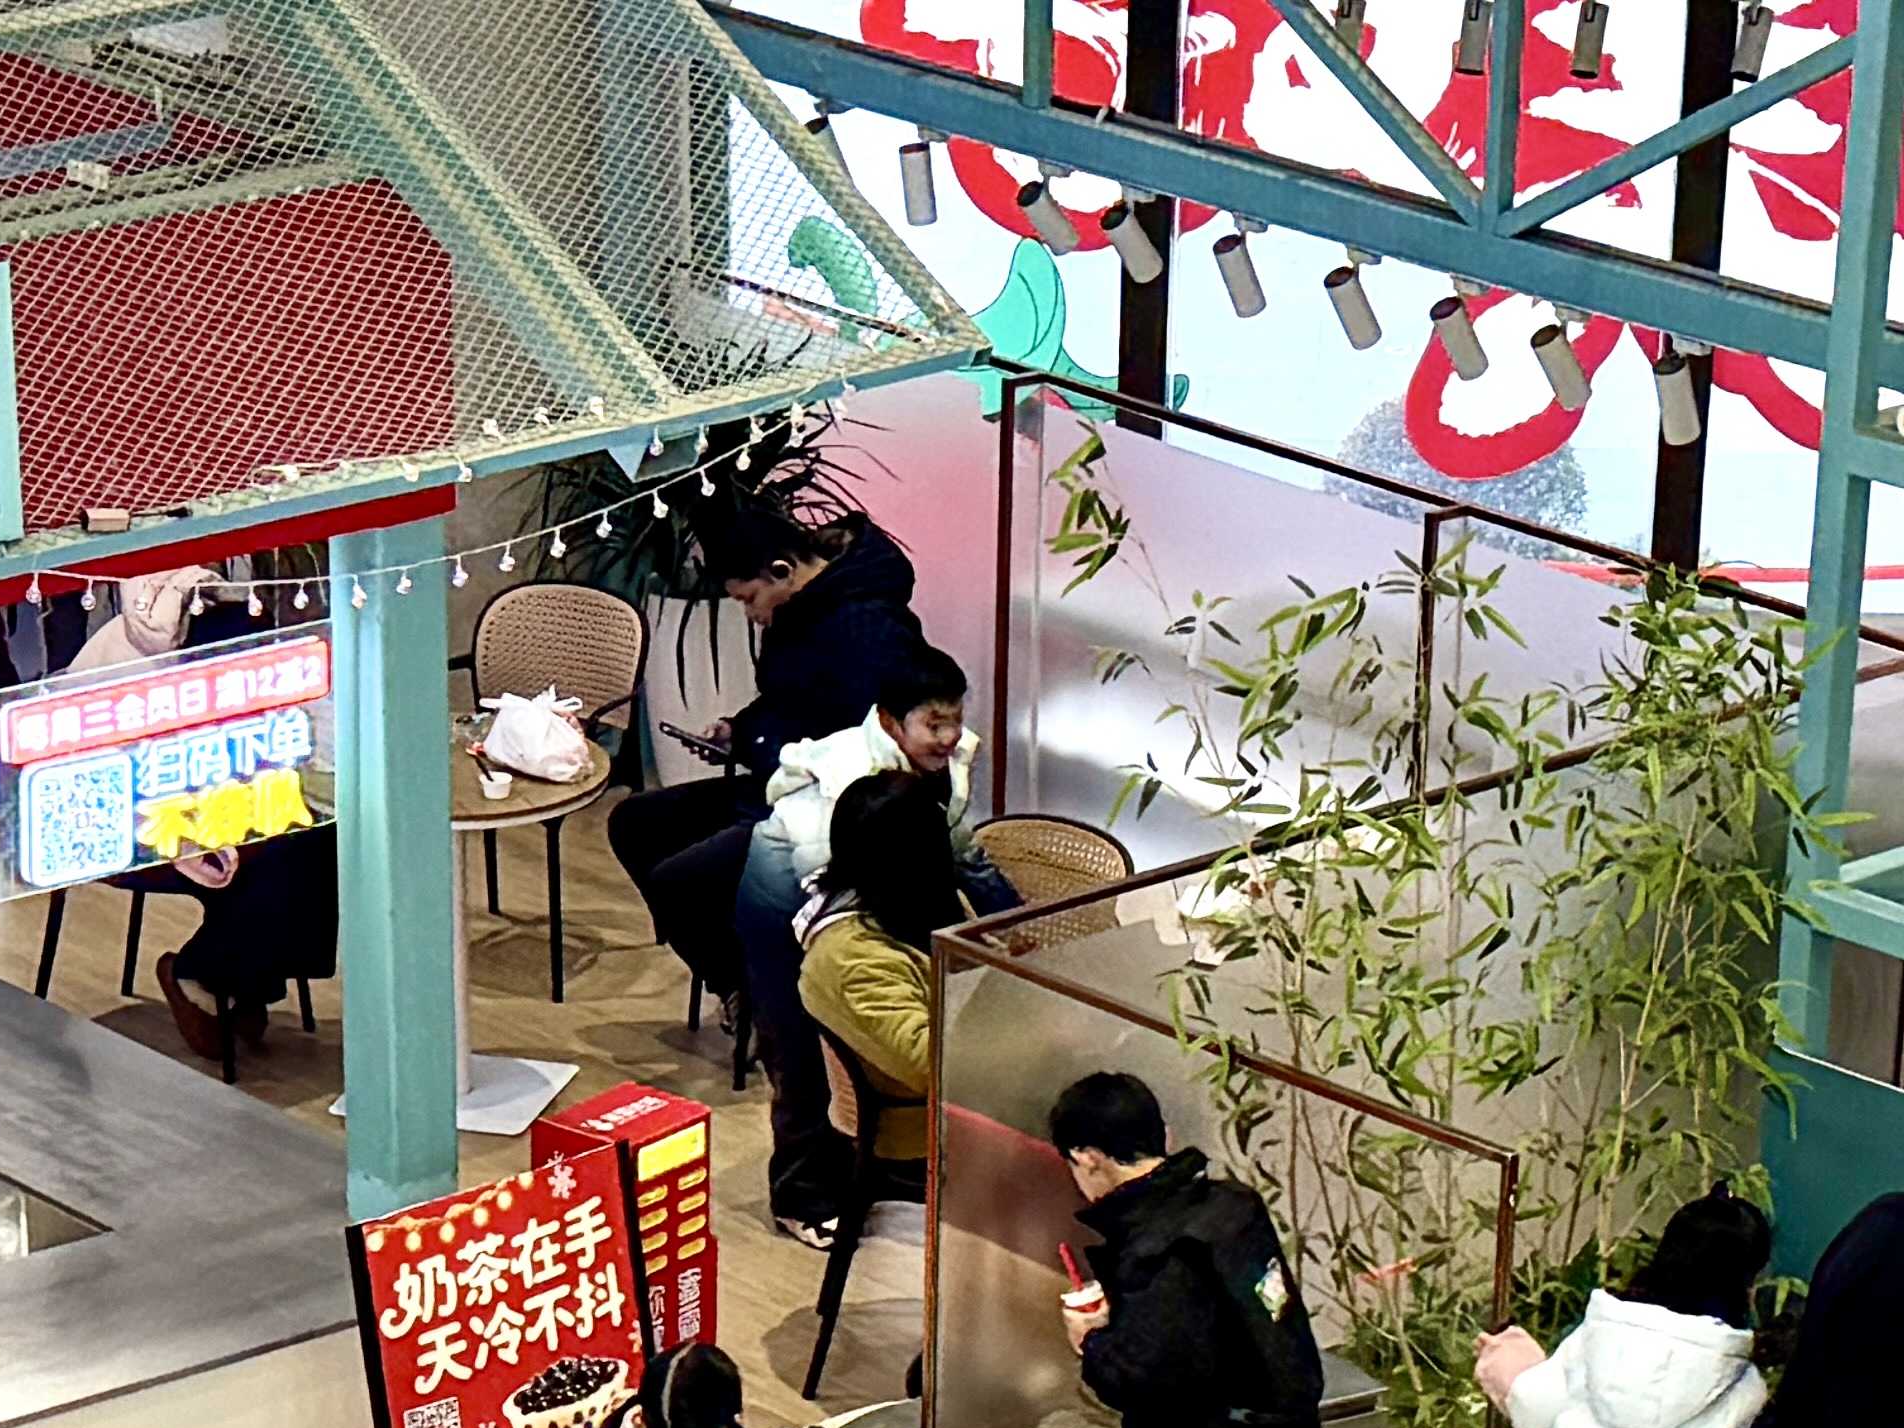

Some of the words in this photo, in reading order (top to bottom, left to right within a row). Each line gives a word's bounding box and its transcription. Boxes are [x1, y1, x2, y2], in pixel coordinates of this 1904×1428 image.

[16, 678, 209, 752] 每周三会员日
[135, 708, 314, 797] 扫码下单
[380, 1197, 613, 1338] 奶茶在手
[415, 1262, 625, 1394] 天冷不抖
